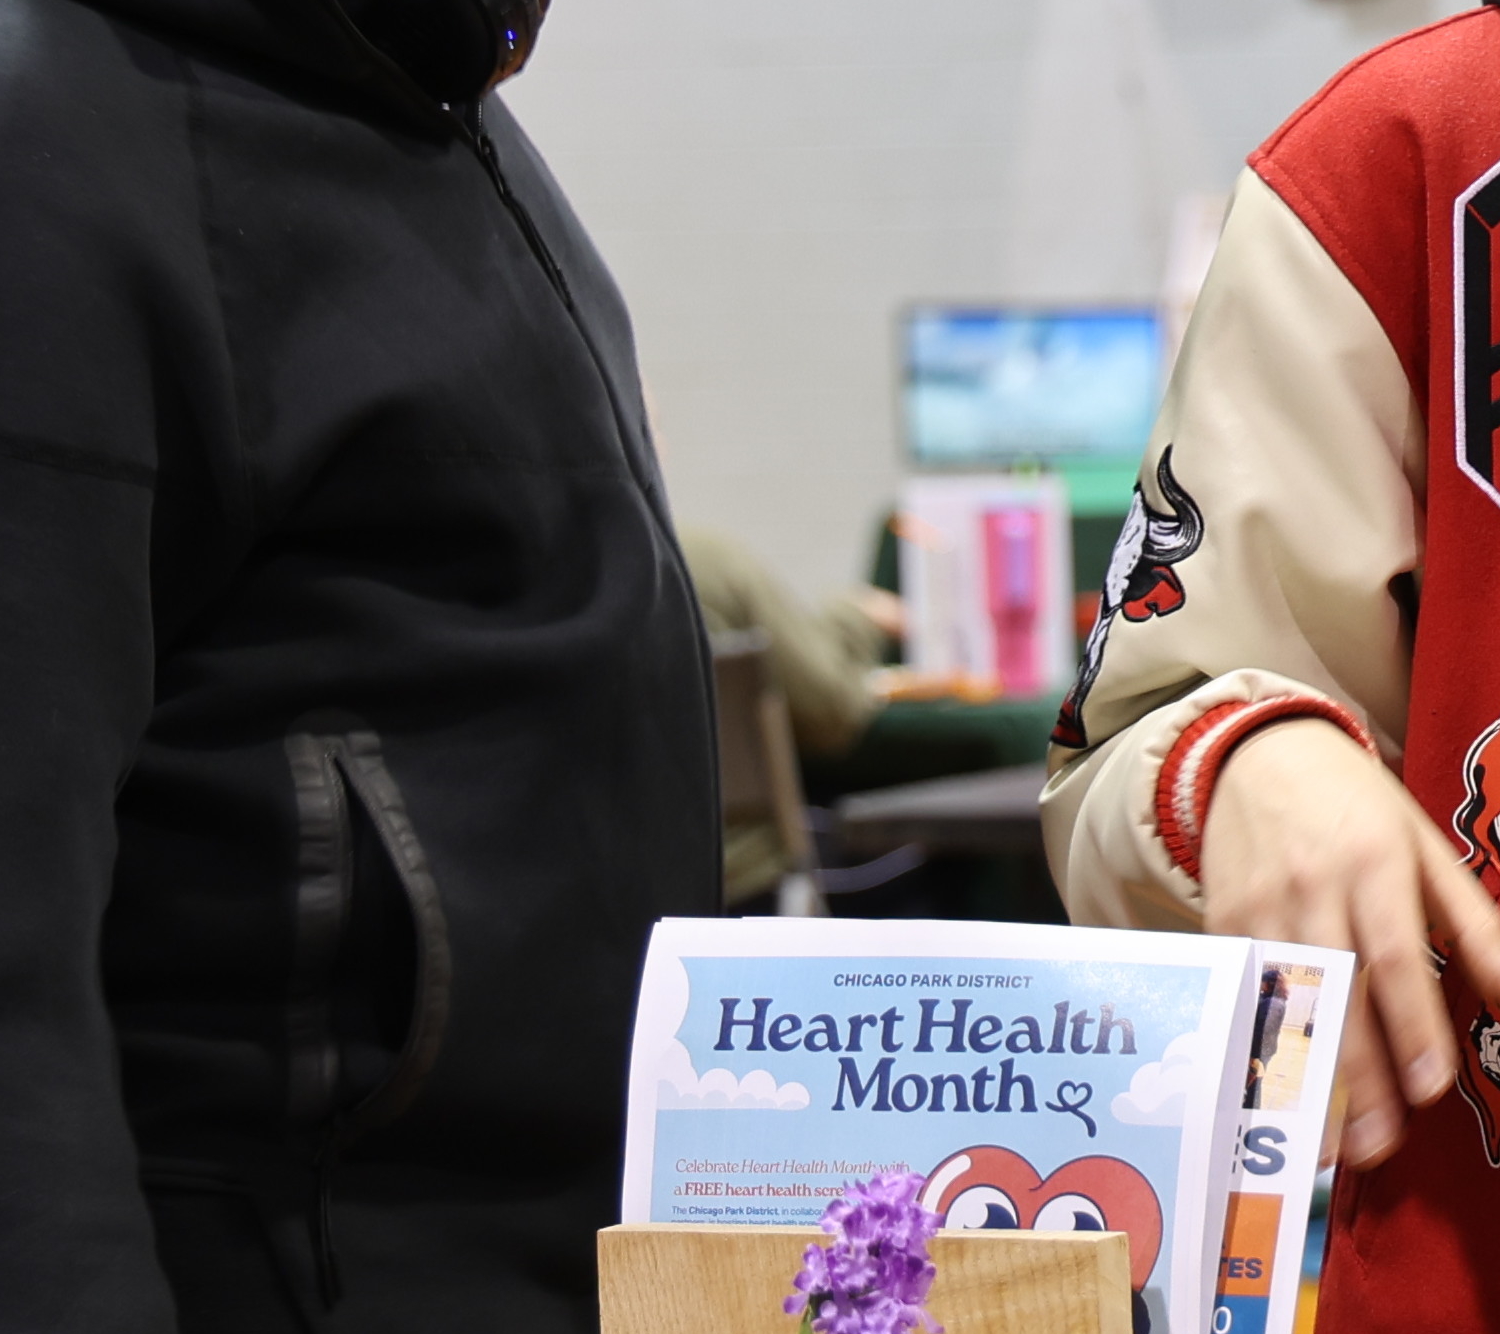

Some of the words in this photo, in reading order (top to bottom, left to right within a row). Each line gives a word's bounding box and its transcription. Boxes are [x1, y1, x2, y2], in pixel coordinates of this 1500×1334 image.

[833, 973, 907, 987] CHICAGO
[910, 974, 952, 987] PARK
[957, 975, 1033, 988] DISTRICT
[713, 998, 904, 1053] Heart
[913, 999, 1137, 1055] Health
[831, 1057, 1038, 1113] Month
[675, 1158, 739, 1174] Celebrate
[740, 1159, 781, 1174] Heart
[782, 1159, 829, 1174] Health
[830, 1159, 876, 1175] Month
[674, 1185, 683, 1196] a
[684, 1182, 724, 1196] FREE
[724, 1182, 765, 1197] heart
[766, 1182, 812, 1197] health
[688, 1206, 724, 1217] Chicago
[725, 1207, 744, 1215] Park
